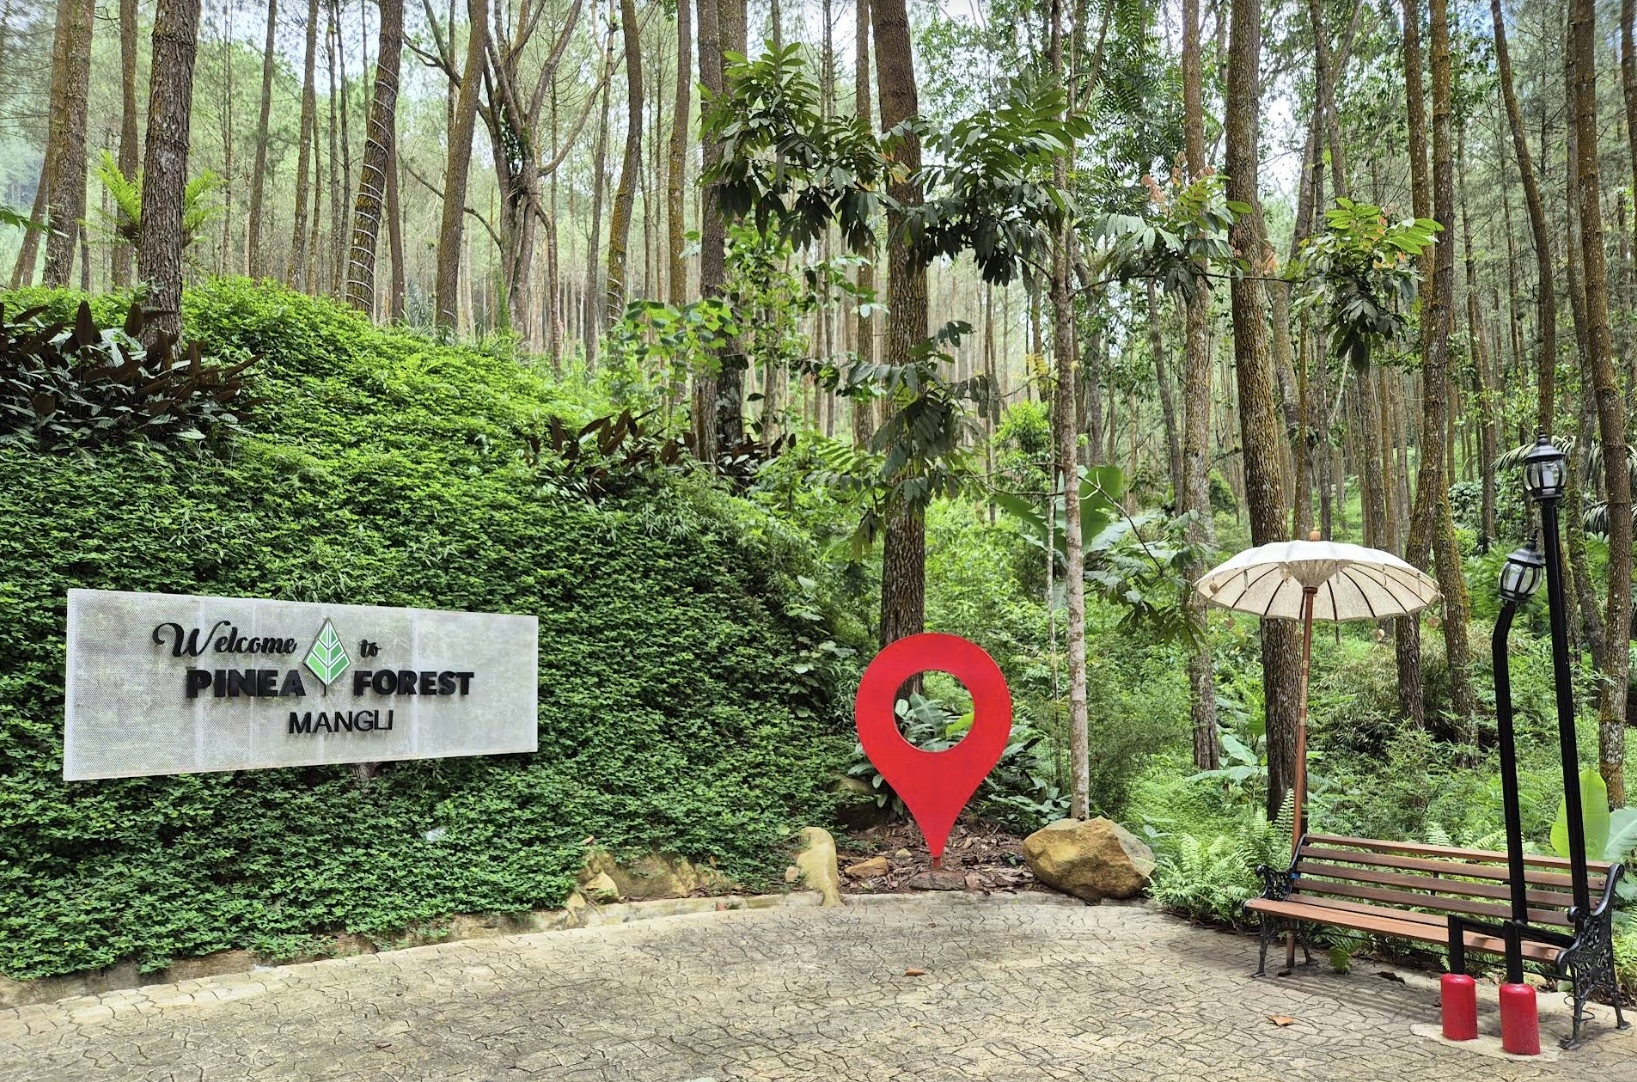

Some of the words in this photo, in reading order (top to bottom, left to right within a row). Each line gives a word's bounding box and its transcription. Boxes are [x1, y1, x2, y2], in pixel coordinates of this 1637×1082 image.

[152, 620, 297, 657] Welcome
[360, 639, 382, 658] to
[186, 668, 306, 698] PINEA
[353, 671, 475, 695] FOREST
[288, 710, 394, 733] MANGLI
